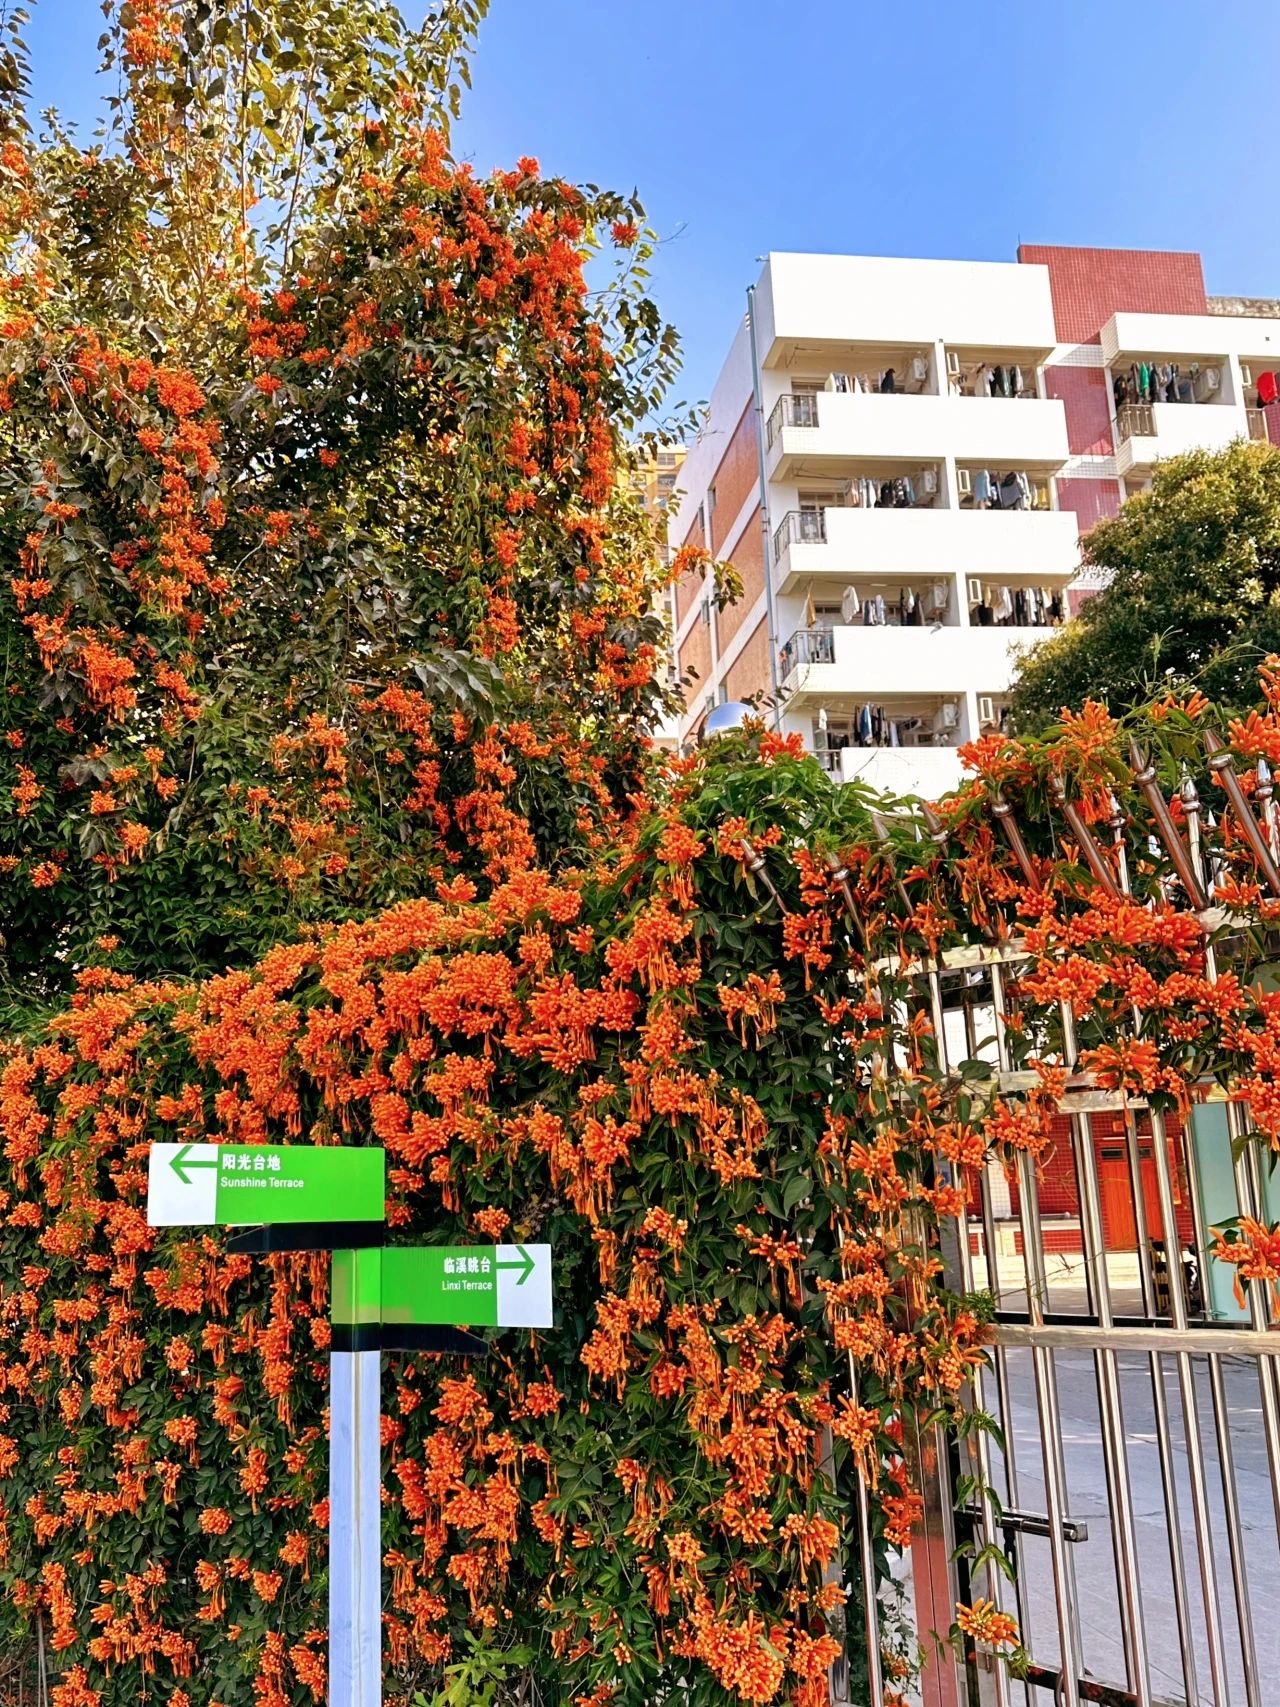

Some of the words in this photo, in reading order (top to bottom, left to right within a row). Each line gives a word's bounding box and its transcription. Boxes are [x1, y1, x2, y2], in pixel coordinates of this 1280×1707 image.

[222, 1153, 281, 1171] 阳光台地
[220, 1176, 267, 1188] Sunshine
[268, 1177, 305, 1188] Terrace
[443, 1256, 491, 1274] 临溪眺台
[441, 1280, 460, 1291] Linxi
[462, 1280, 493, 1291] Terrace
